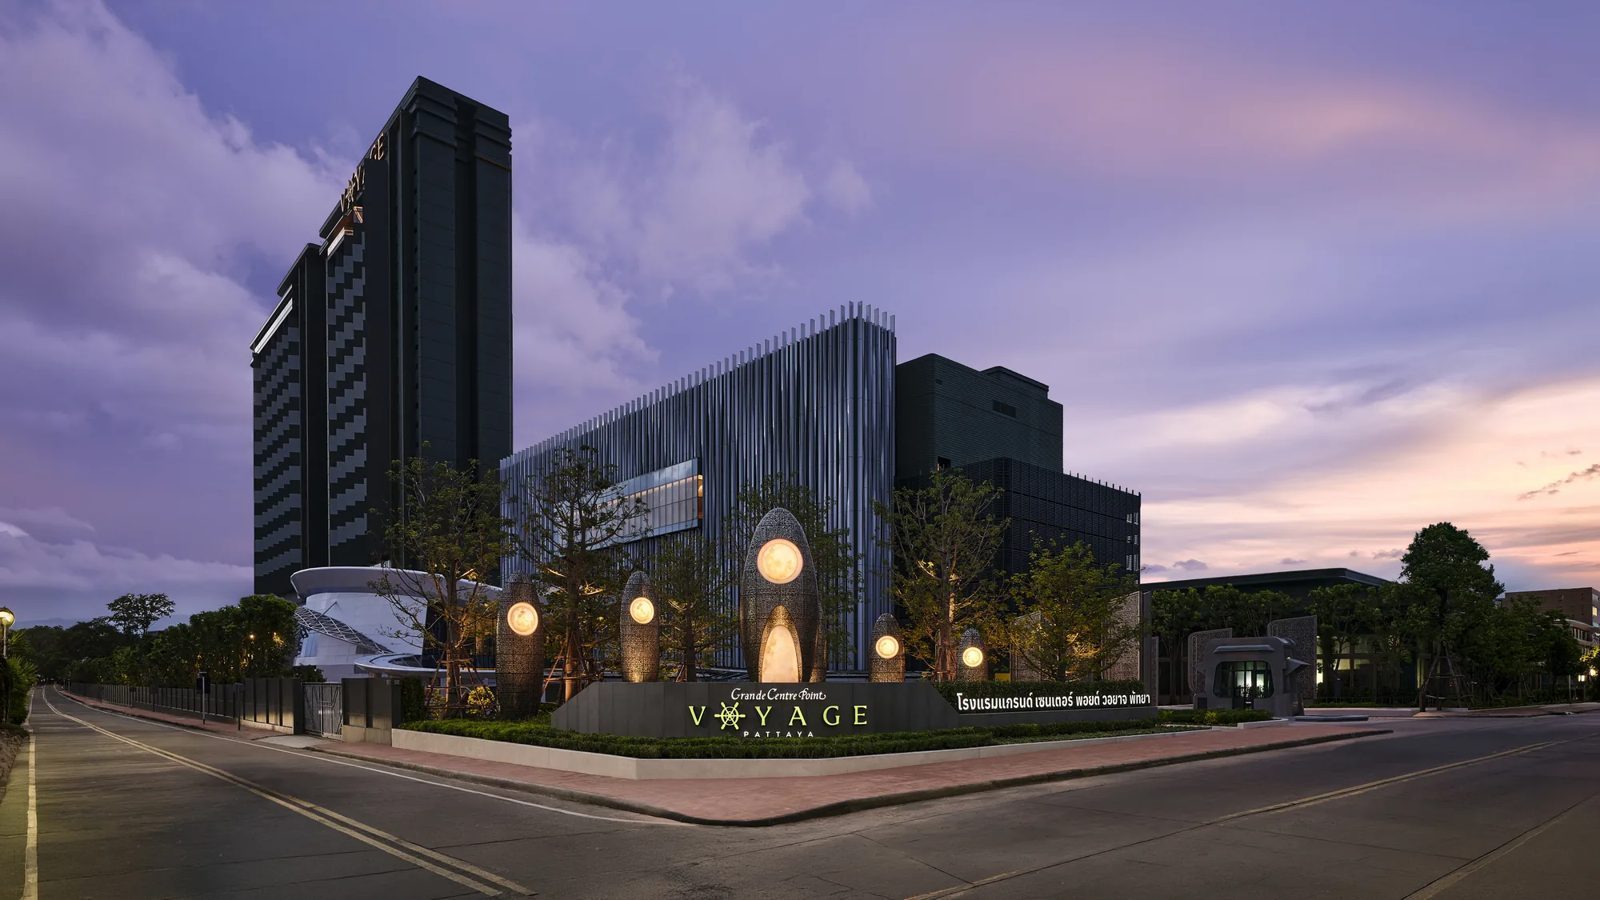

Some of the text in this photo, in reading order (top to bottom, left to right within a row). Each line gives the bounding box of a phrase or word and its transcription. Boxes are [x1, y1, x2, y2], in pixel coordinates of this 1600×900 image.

[730, 687, 827, 701] Grande Centre Point
[956, 692, 1033, 711] โรงแรมแกรนด์
[1075, 690, 1100, 706] พอยต์
[1102, 694, 1128, 705] วอยาจ
[1129, 690, 1151, 704] พัทยา
[743, 730, 814, 738] PATTAYA
